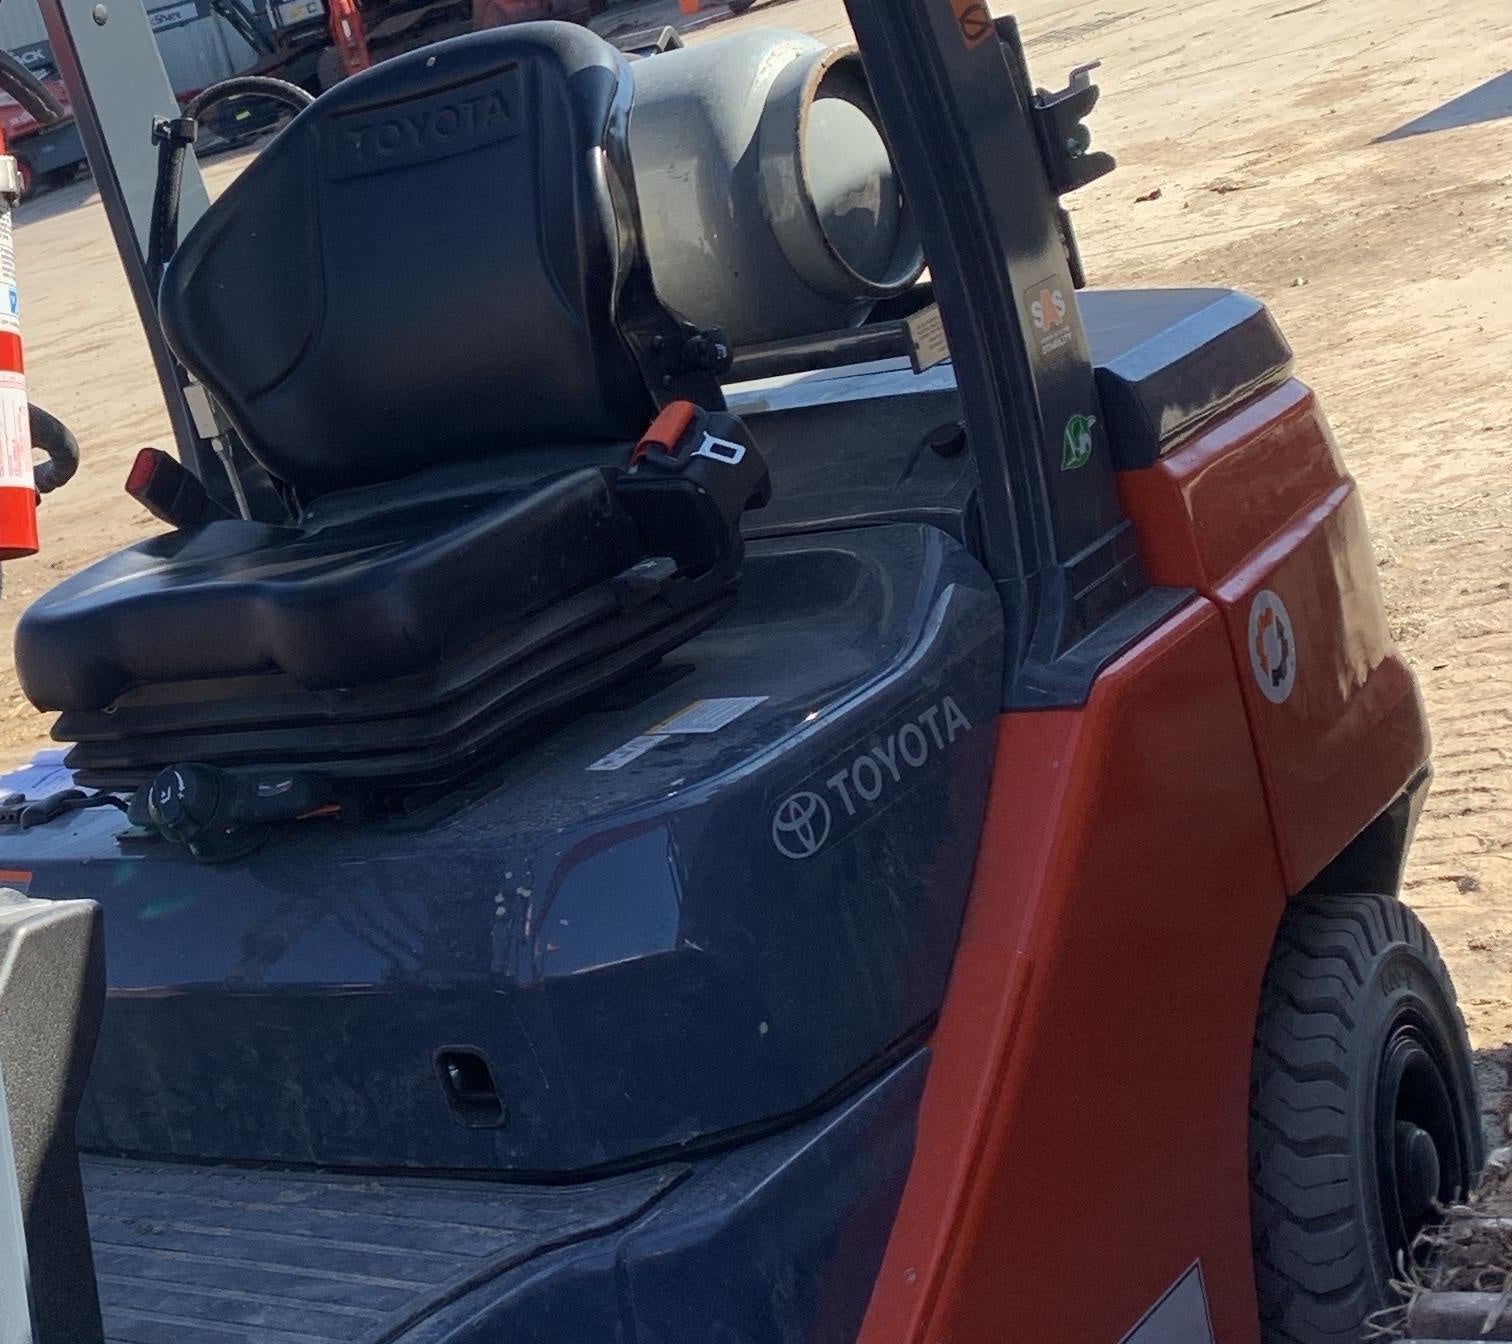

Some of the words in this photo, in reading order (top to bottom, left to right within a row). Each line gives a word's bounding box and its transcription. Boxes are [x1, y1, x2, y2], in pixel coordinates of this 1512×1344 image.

[348, 87, 511, 164] TOYOTA
[1030, 288, 1066, 331] SAS
[826, 695, 972, 817] TOYOTA
